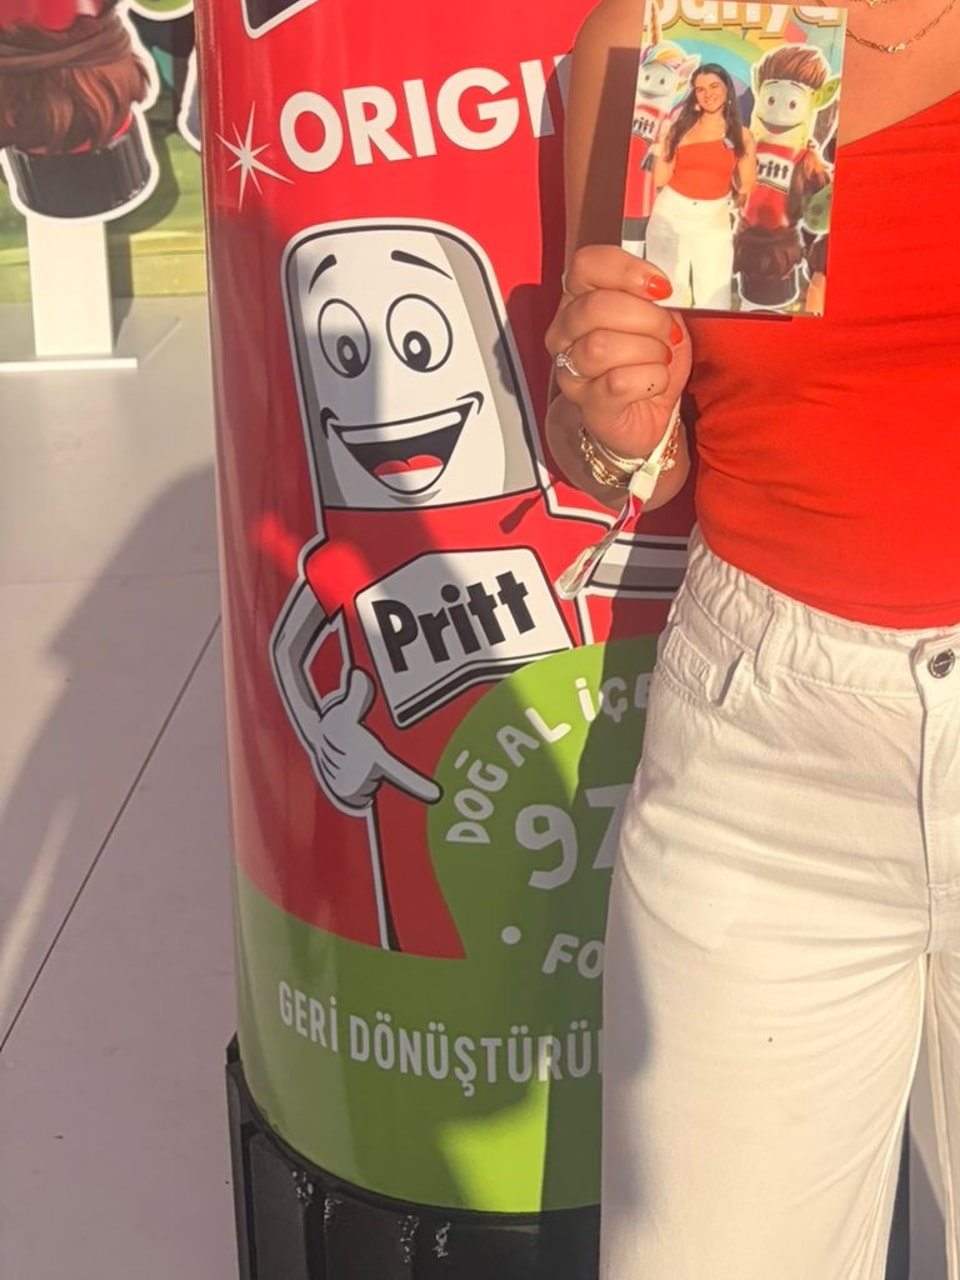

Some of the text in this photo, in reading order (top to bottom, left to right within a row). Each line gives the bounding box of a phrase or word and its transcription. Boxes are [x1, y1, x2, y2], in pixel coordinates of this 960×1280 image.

[371, 570, 536, 673] Pritt
[445, 707, 572, 844] DOĞAL
[278, 981, 603, 1097] GERİ DÖNÜŞTÜRÜ
